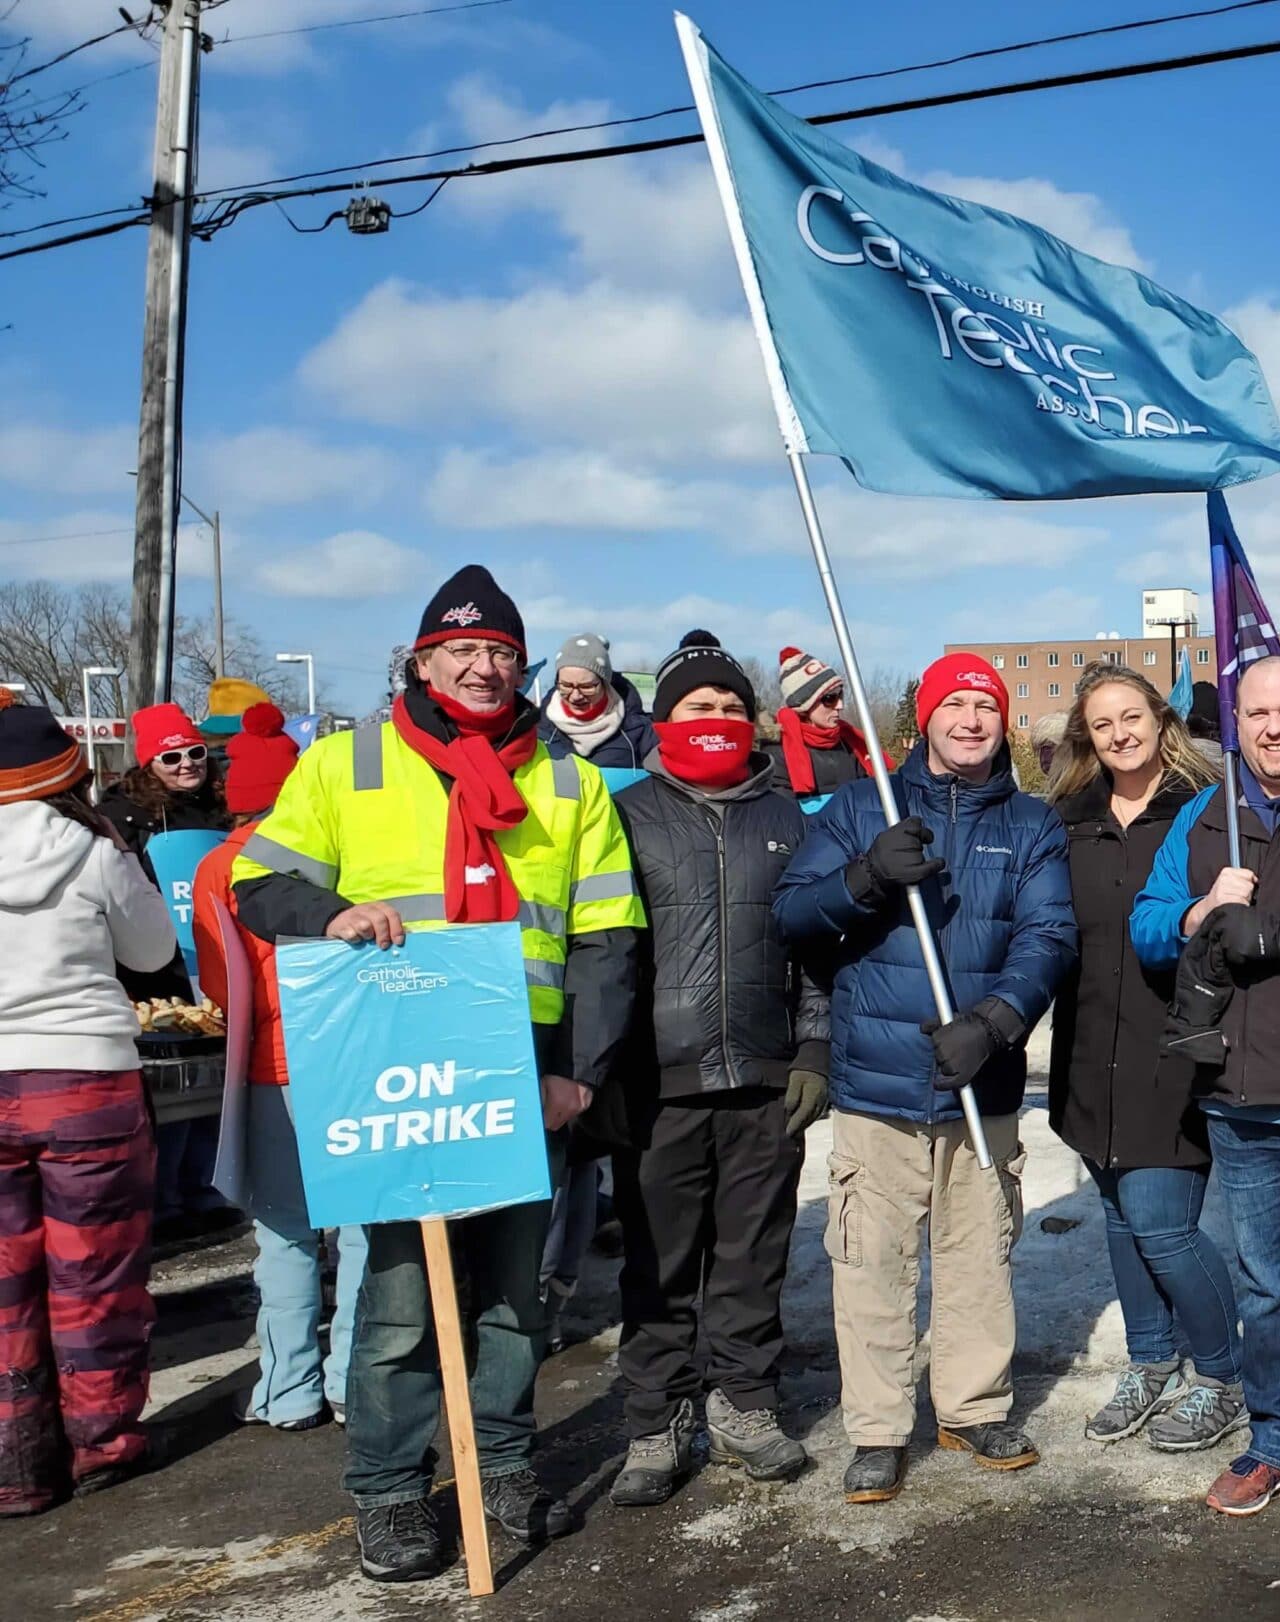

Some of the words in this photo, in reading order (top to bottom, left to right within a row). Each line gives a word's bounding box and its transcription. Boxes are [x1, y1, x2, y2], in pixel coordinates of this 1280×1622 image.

[688, 734, 726, 746] Catholic
[356, 965, 421, 983] Catholic
[378, 976, 448, 994] Teachers
[375, 1060, 456, 1103] ON
[326, 1099, 516, 1156] STRIKE
